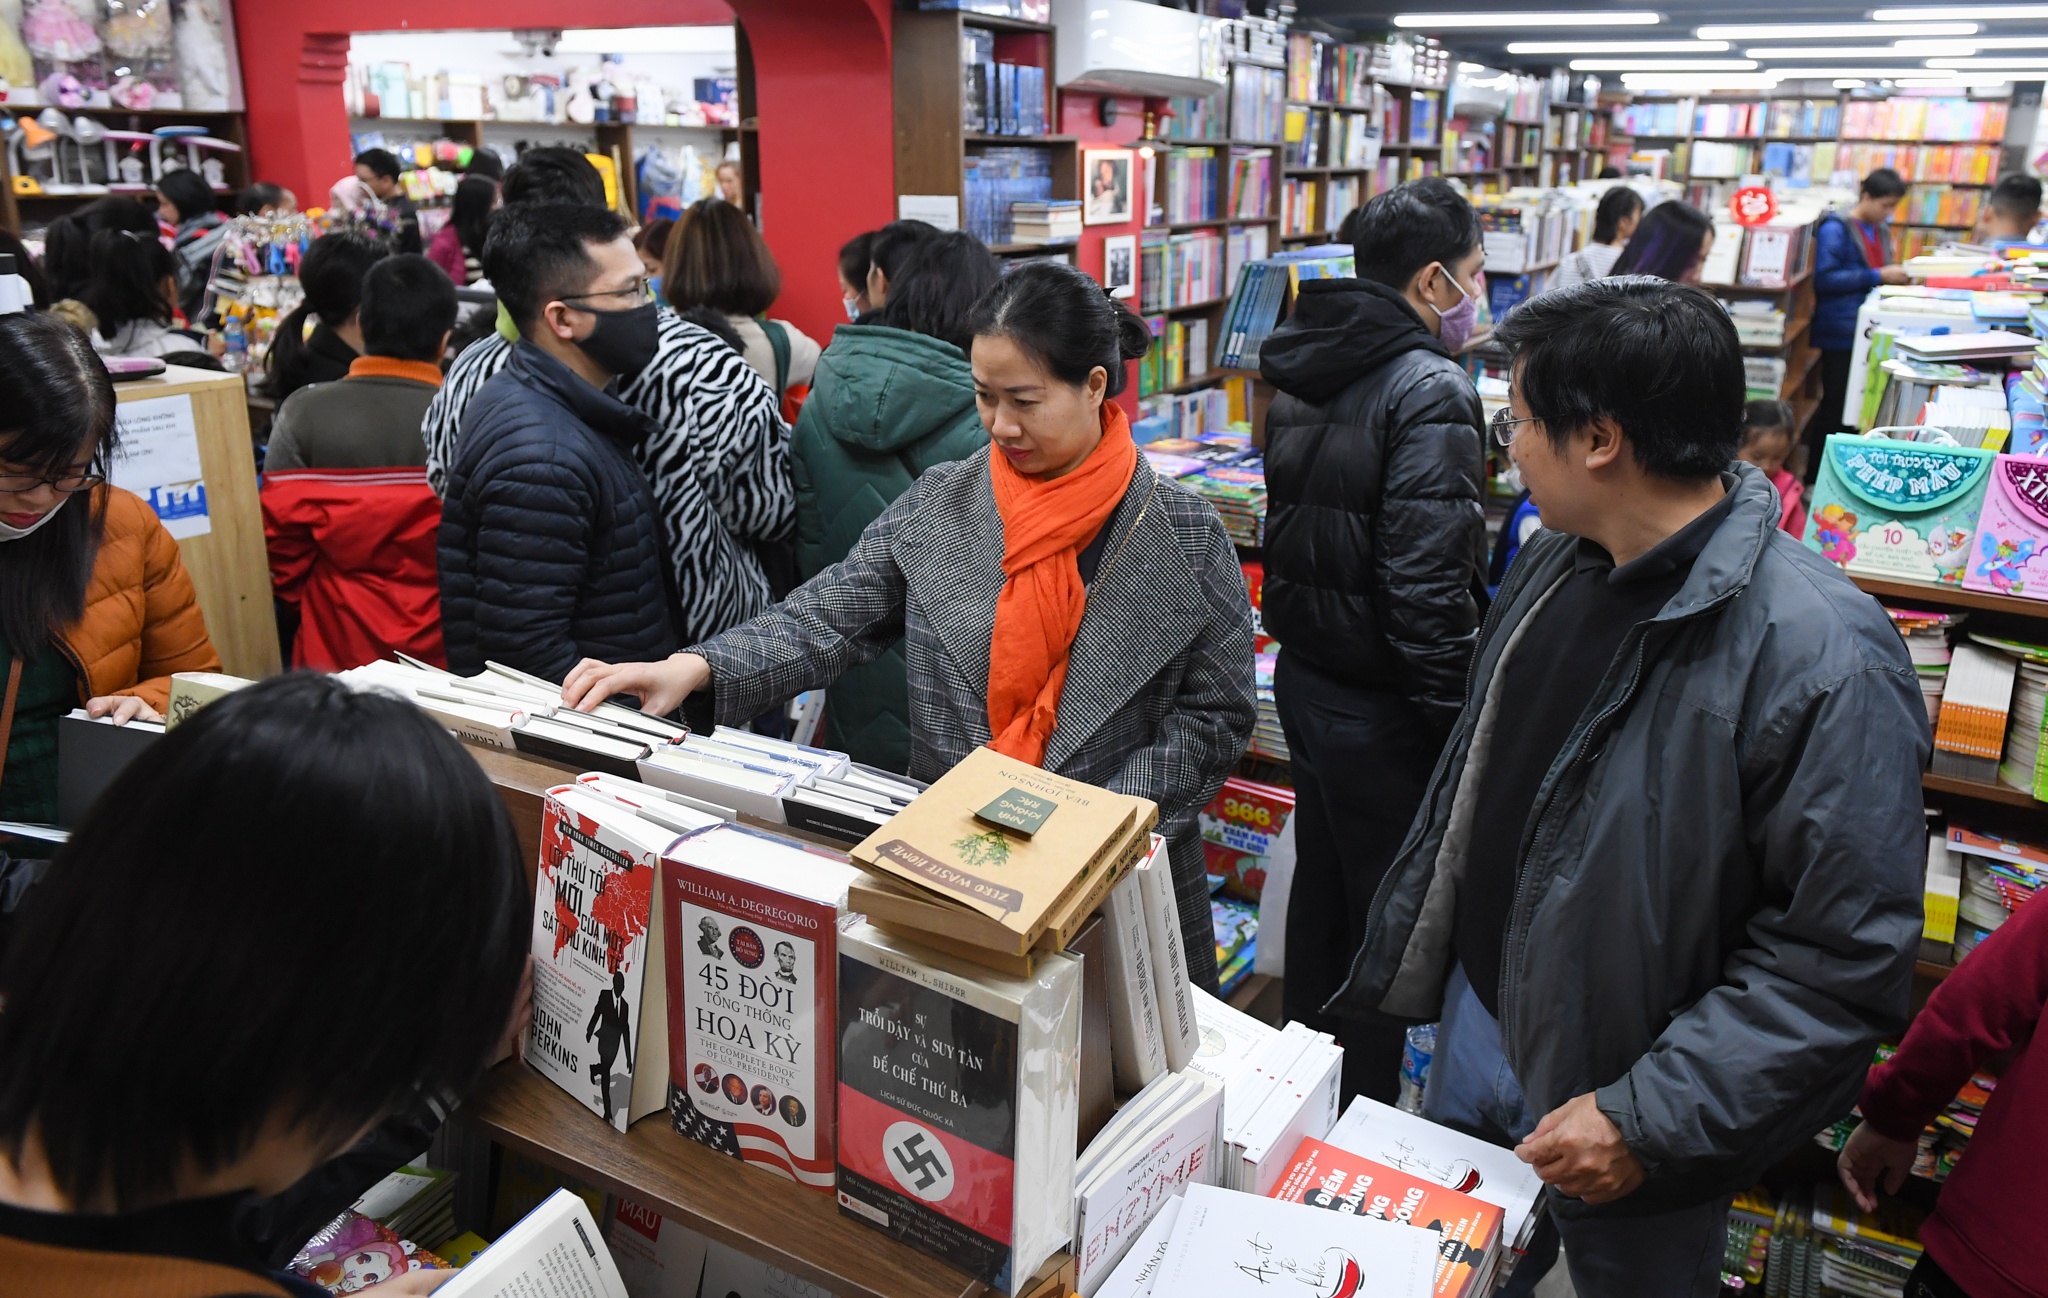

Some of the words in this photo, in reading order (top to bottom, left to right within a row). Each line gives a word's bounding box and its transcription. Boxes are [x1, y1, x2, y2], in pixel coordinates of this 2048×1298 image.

[1846, 452, 1903, 494] PHÉP
[1908, 461, 1962, 495] MÀU
[1883, 528, 1902, 545] 10
[998, 769, 1061, 799] JOHNSON
[1065, 793, 1091, 807] BEA
[998, 811, 1025, 826] NHÀ
[1000, 799, 1044, 822] KHÔNG
[1020, 795, 1042, 809] RÁC
[562, 823, 572, 837] NEW
[573, 828, 585, 844] YORK
[585, 836, 600, 852] TIMES
[600, 842, 630, 868] BESTSELLER
[892, 844, 925, 867] HOME
[566, 854, 586, 886] THÚ
[589, 867, 606, 898] TỘI
[926, 863, 971, 888] WASTE
[555, 876, 584, 918] MỚI
[677, 878, 726, 903] WILLIAM
[728, 896, 738, 907] A.
[740, 898, 818, 930] DEGREGORIO
[976, 883, 1011, 903] ZERO
[542, 909, 560, 938] SÁT
[582, 937, 606, 968] KINH
[580, 913, 600, 942] CỦA
[879, 957, 917, 978] WILLIAM
[1136, 957, 1148, 994] BEIRUT
[698, 962, 728, 991] 45
[738, 973, 794, 1015] ĐỜI
[1168, 936, 1180, 974] BEIRUT
[1175, 984, 1190, 1040] JERUSALEM
[532, 1006, 562, 1040] JOHN
[704, 990, 740, 1013] TỔNG
[744, 1004, 792, 1031] THỐNG
[915, 1013, 927, 1029] SỰ
[531, 1024, 578, 1074] PERKINS
[695, 1006, 756, 1050] HOA
[764, 1030, 802, 1065] KỲ
[859, 1007, 884, 1030] TRỖI
[887, 1018, 911, 1041] DẬY
[914, 1033, 927, 1048] VÀ
[931, 1039, 954, 1060] SUY
[958, 1049, 983, 1072] TÀN
[699, 1037, 718, 1051] THE
[720, 1044, 767, 1069] COMPLETE
[769, 1064, 796, 1080] BOOK
[706, 1050, 718, 1060] OF
[720, 1054, 735, 1067] U.S.
[736, 1060, 790, 1087] PRESIDENTS
[911, 1052, 930, 1069] CỦA
[873, 1055, 889, 1074] ĐẾ
[892, 1064, 917, 1086] CHẾ
[921, 1076, 947, 1099] THỨ
[950, 1089, 968, 1109] BA
[880, 1089, 895, 1103] LỊCH
[896, 1095, 906, 1106] SỬ
[906, 1099, 922, 1114] ĐỨC
[922, 1106, 943, 1123] QUỐC
[1125, 1166, 1155, 1196] NHÂN
[1156, 1150, 1171, 1168] TỐ
[1127, 1152, 1150, 1176] HIROMI
[1314, 1168, 1348, 1207] ĐIỂM
[857, 1182, 871, 1194] trong
[872, 1189, 890, 1203] những
[917, 1210, 928, 1220] lịch
[936, 1219, 951, 1232] quan
[952, 1226, 968, 1241] trọng
[968, 1233, 983, 1247] nhất
[1084, 1144, 1207, 1276] ENZYME
[1187, 1204, 1202, 1238] NAGUMO
[915, 1219, 928, 1230] New
[929, 1225, 943, 1237] York
[1246, 1232, 1273, 1256] ít
[1439, 1221, 1453, 1247] TRACY
[1452, 1218, 1468, 1241] STEIN
[1135, 1254, 1162, 1284] NHÂN
[1234, 1256, 1280, 1285] Ăn
[1295, 1256, 1330, 1288] khỏe
